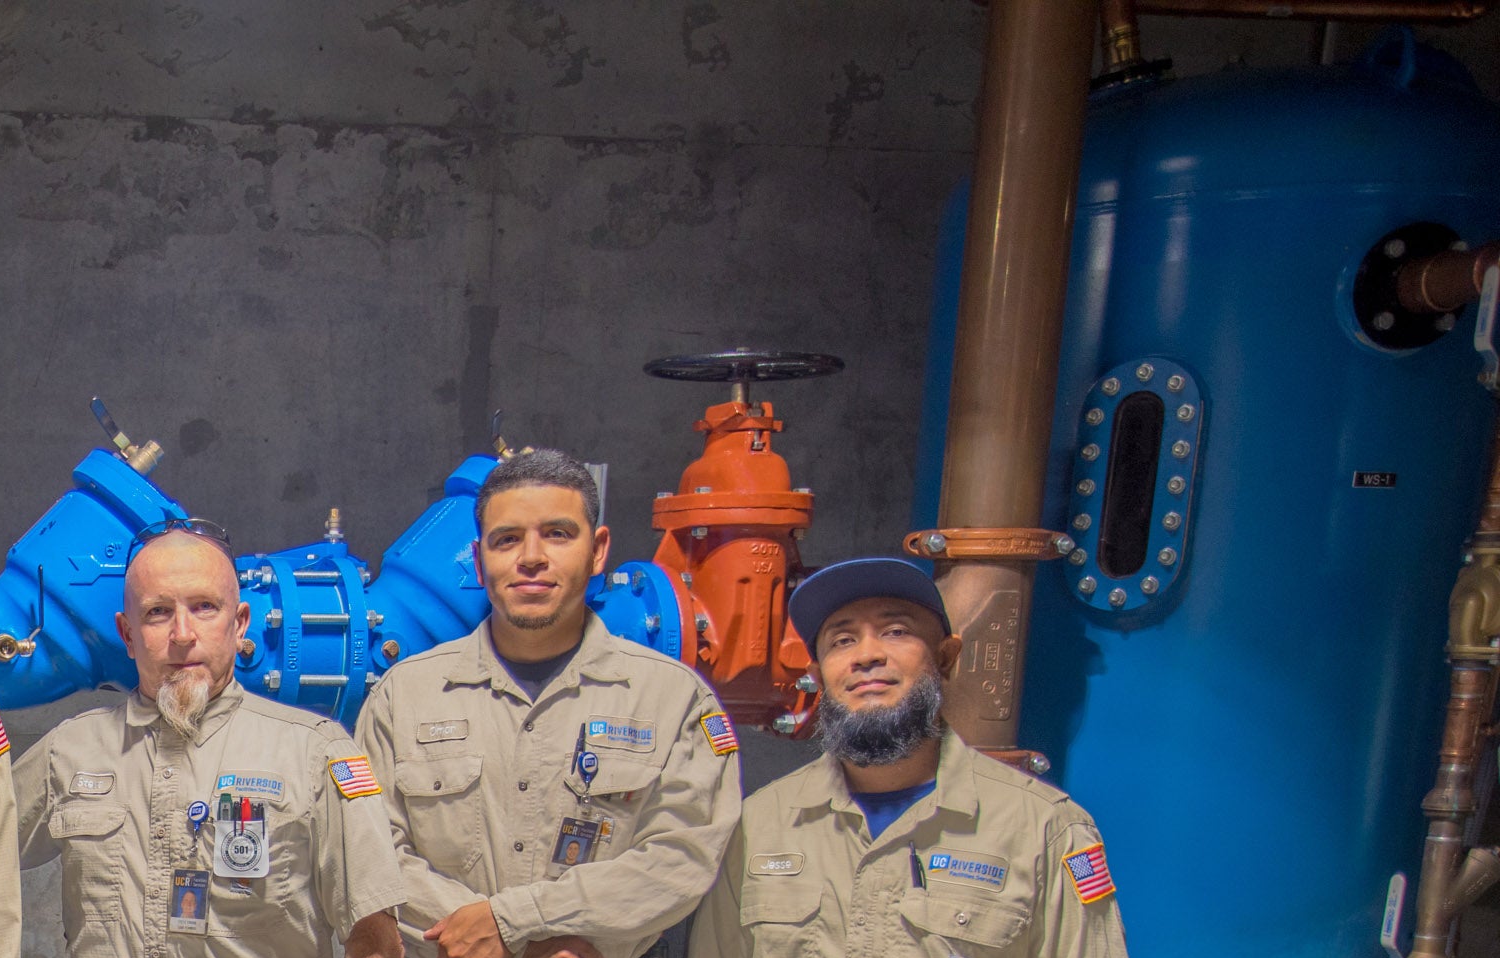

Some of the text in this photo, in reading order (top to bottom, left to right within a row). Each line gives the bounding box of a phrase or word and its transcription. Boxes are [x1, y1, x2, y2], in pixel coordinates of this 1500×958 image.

[1363, 474, 1390, 485] WS-1
[607, 725, 653, 740] RIVERSIDE
[235, 777, 283, 791] RIVERSIDE
[234, 845, 249, 855] 501
[760, 859, 792, 869] Jesse
[950, 859, 1006, 879] RIVERSIDE
[174, 876, 191, 887] UCR
